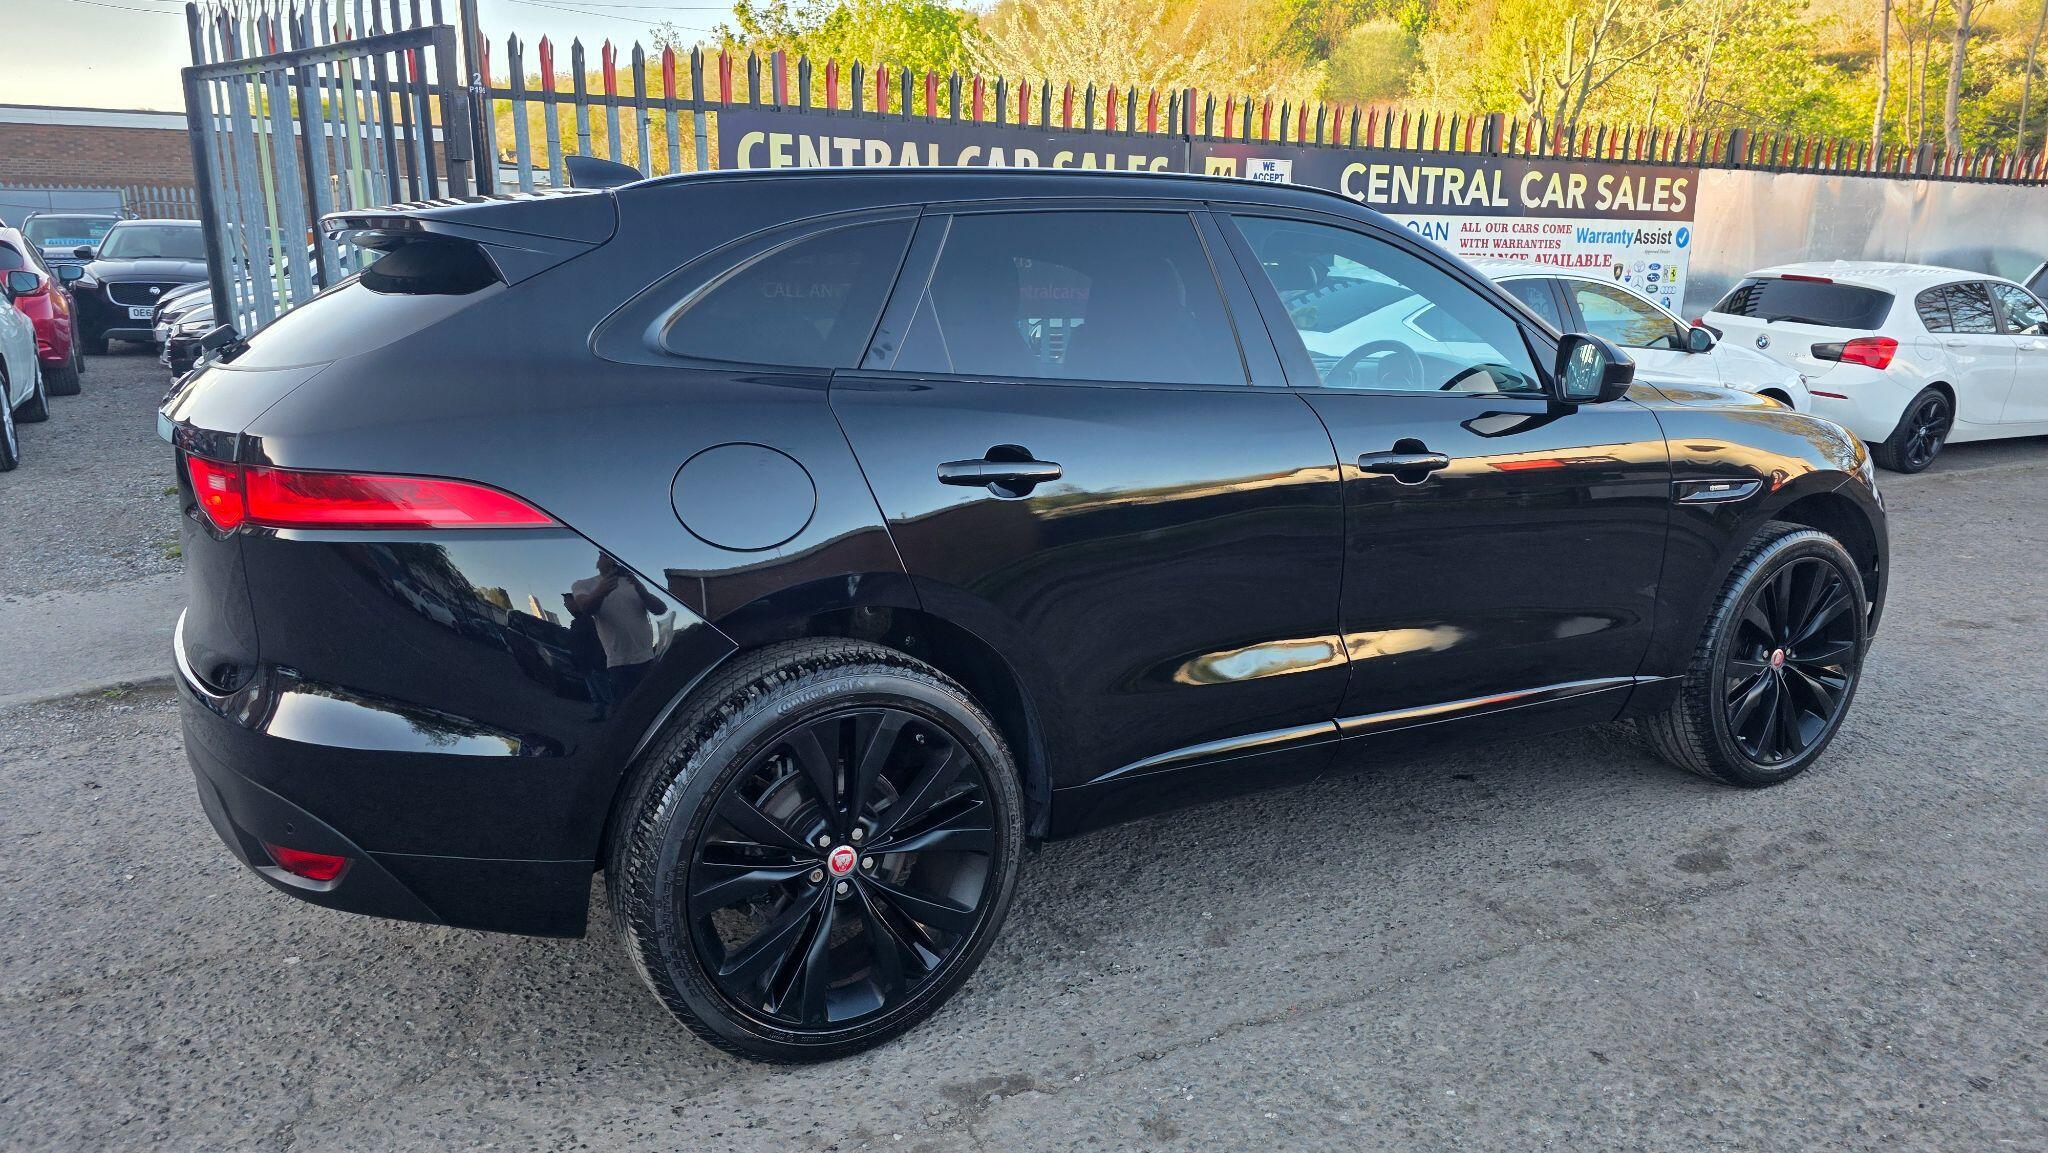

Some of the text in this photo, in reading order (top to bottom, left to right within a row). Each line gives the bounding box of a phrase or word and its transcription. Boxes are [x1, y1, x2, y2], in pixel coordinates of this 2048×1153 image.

[473, 72, 482, 85] 2
[1262, 161, 1276, 171] WE
[1252, 172, 1284, 182] ACCEPT
[1340, 163, 1688, 212] CENTRAL CAR SALES
[1461, 222, 1573, 234] ALL OUR CARS COME
[1460, 238, 1562, 249] WITH WARRANTIES
[1535, 253, 1612, 267] AVAILABLE
